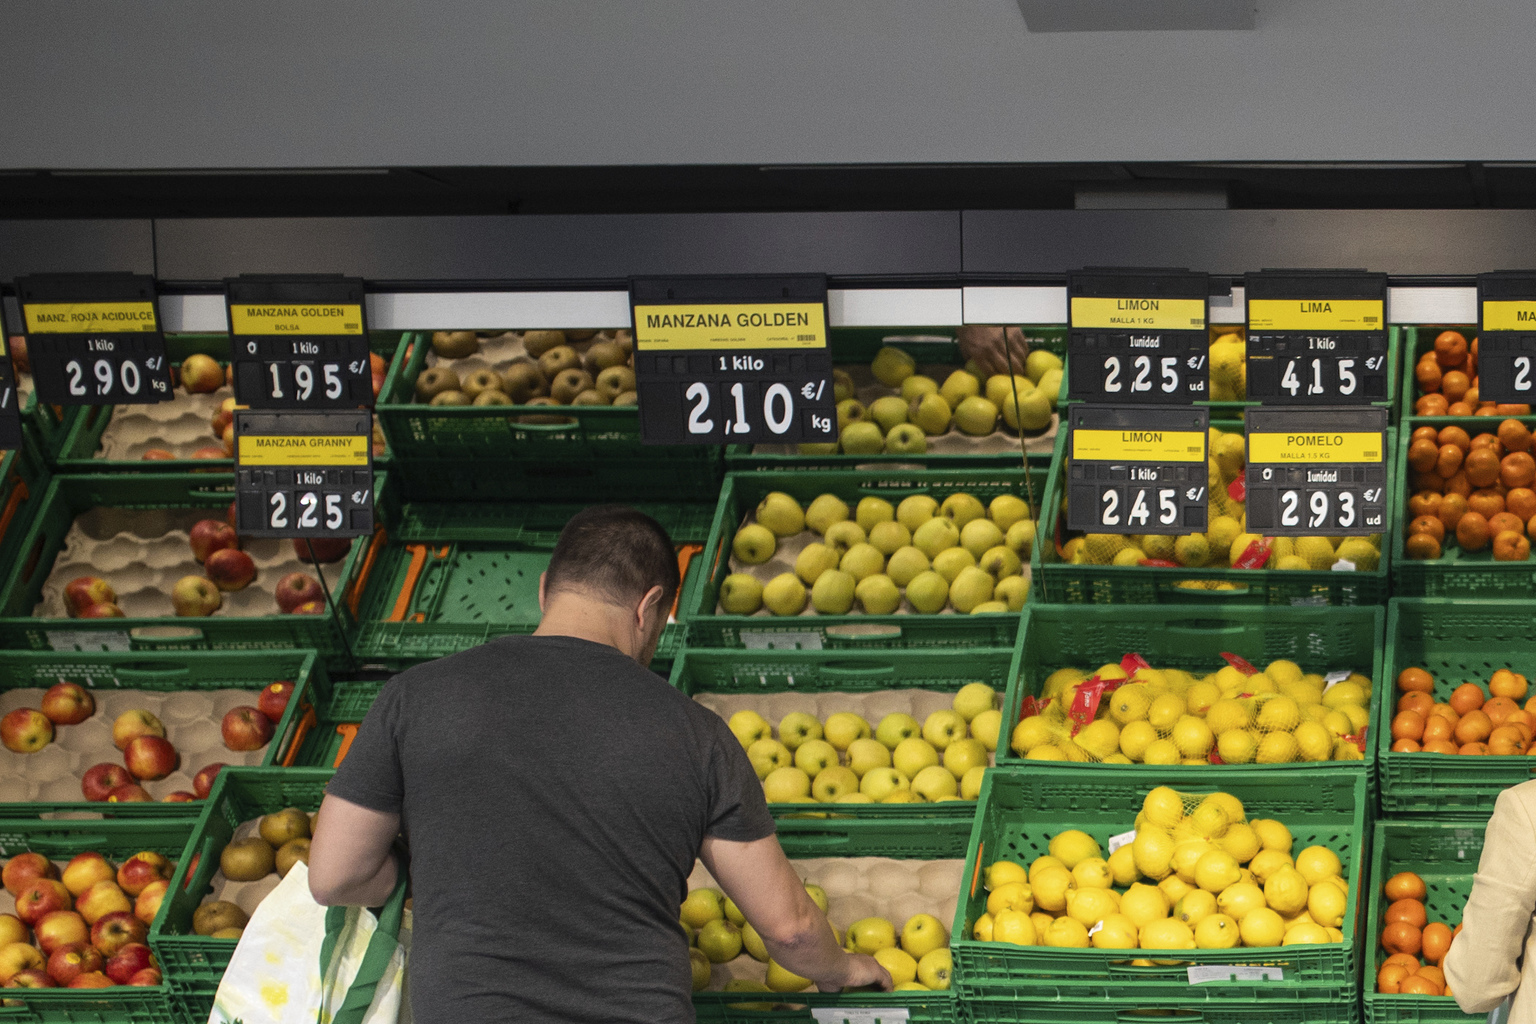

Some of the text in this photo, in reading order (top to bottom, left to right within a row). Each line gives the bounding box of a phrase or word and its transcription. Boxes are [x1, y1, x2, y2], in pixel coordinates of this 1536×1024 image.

[247, 308, 344, 317] MANZANA GOLDEN
[1300, 302, 1332, 313] LIMA
[36, 311, 153, 323] MANZ. ROJA ACIDULCE
[647, 312, 809, 329] MANZANA GOLDEN
[88, 339, 114, 351] 1 kilo
[292, 342, 319, 354] 1 kilo
[1308, 337, 1336, 350] 1 kilo
[719, 356, 764, 371] 1 kilo
[152, 379, 167, 392] kg
[1189, 380, 1204, 391] ud
[812, 414, 831, 433] kg
[256, 438, 353, 448] MANZANA GRANNY
[1287, 435, 1343, 446] POMELO
[296, 472, 323, 485] 1 kilo
[1130, 468, 1157, 481] 1 kilo
[1366, 514, 1382, 526] ud
